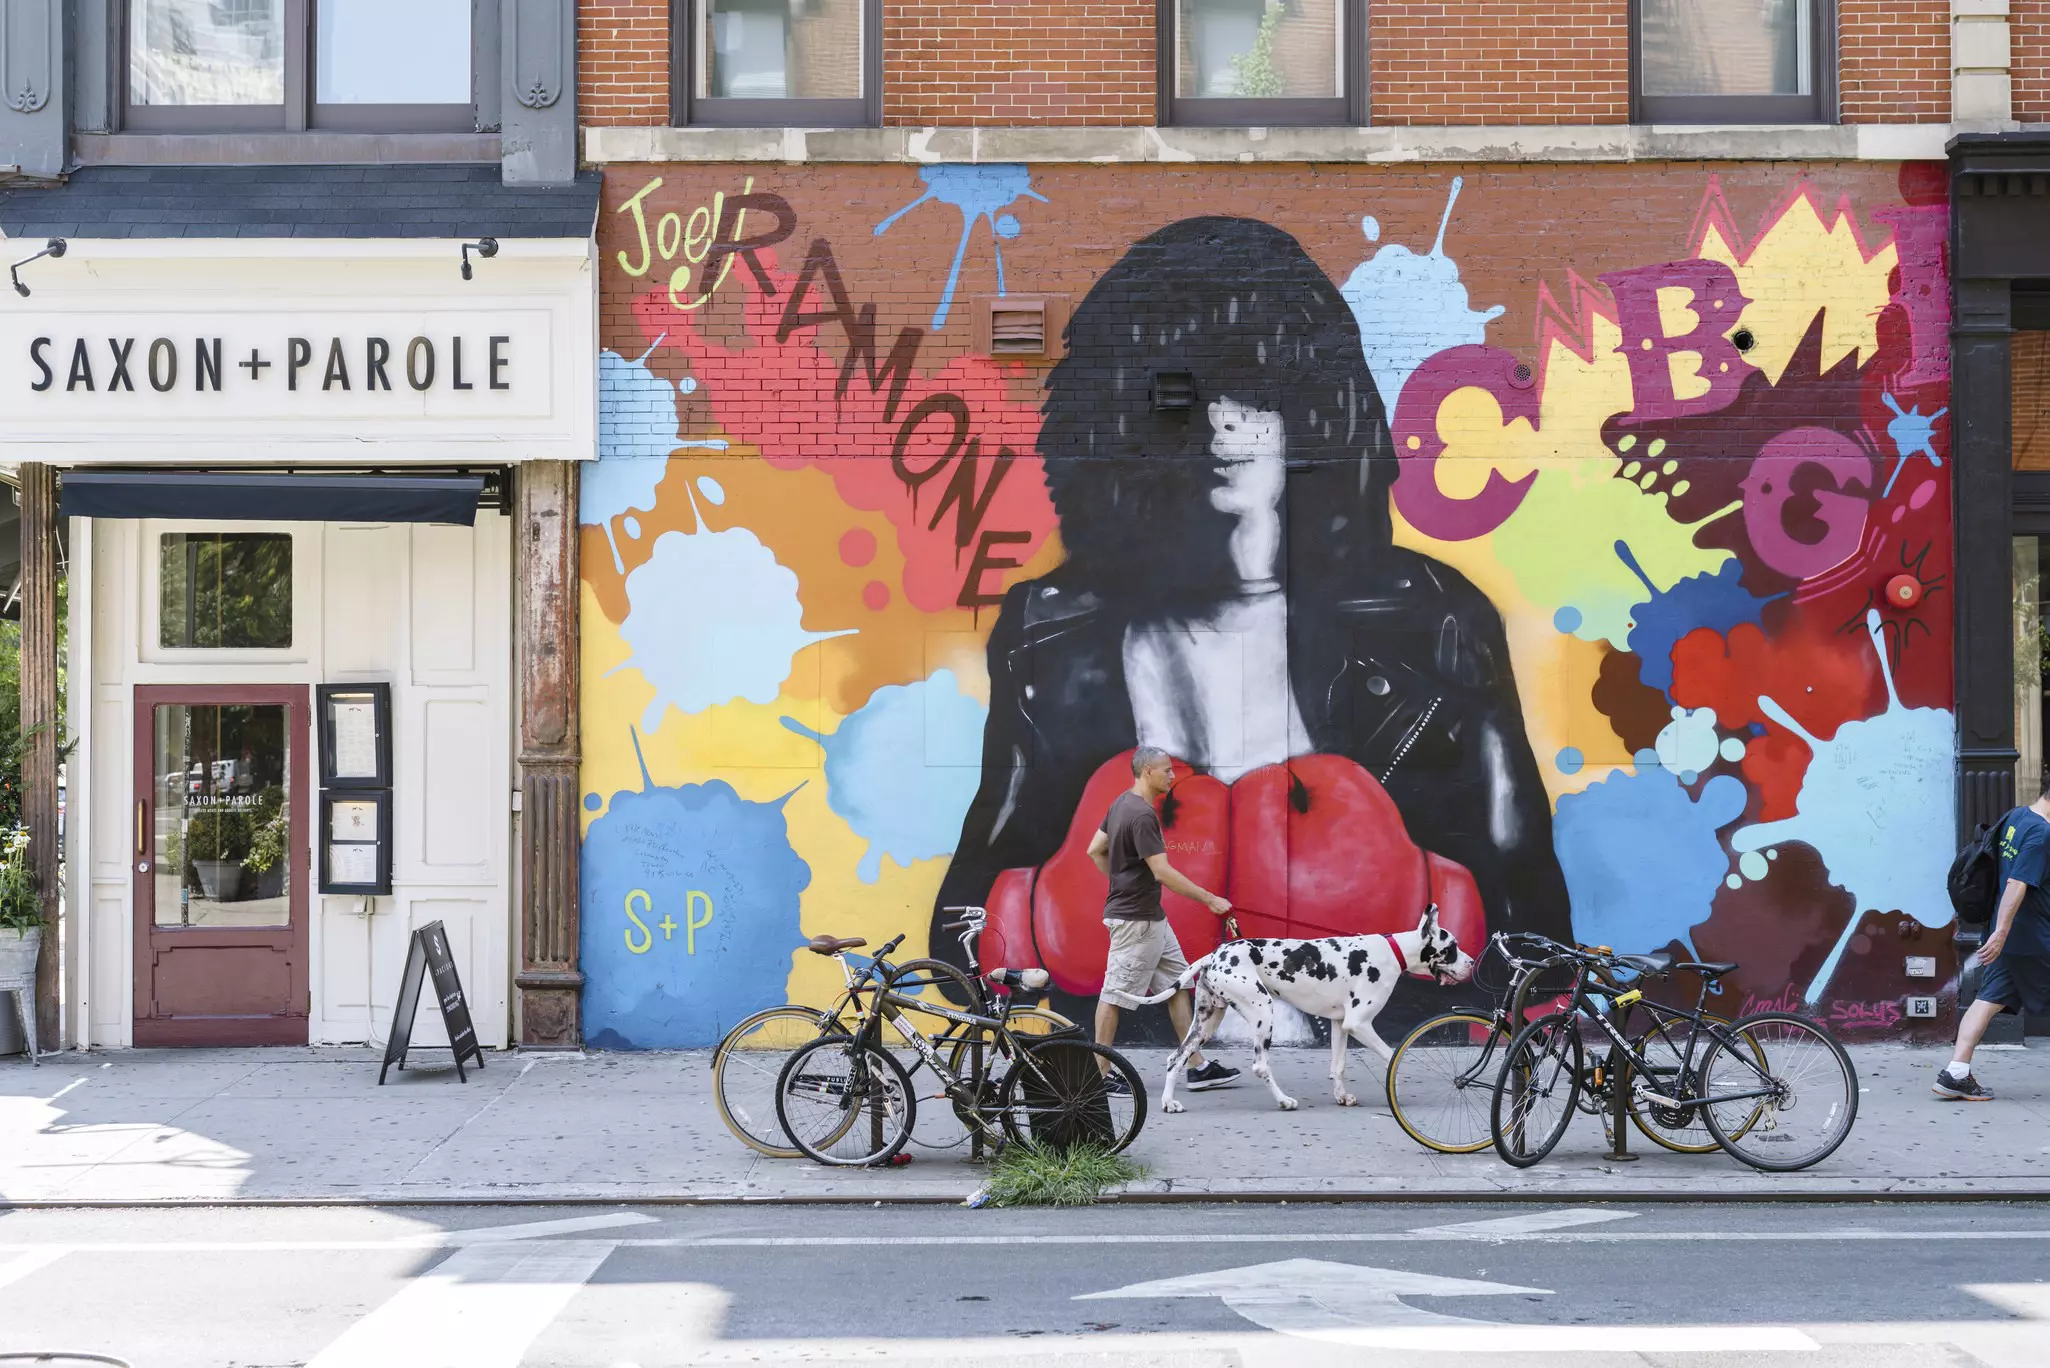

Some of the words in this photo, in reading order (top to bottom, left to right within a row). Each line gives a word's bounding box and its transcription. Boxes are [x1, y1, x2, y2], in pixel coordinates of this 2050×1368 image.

[699, 193, 1032, 610] RAMONE
[946, 1011, 977, 1025] TUNDRA
[1596, 1011, 1640, 1060] TREK
